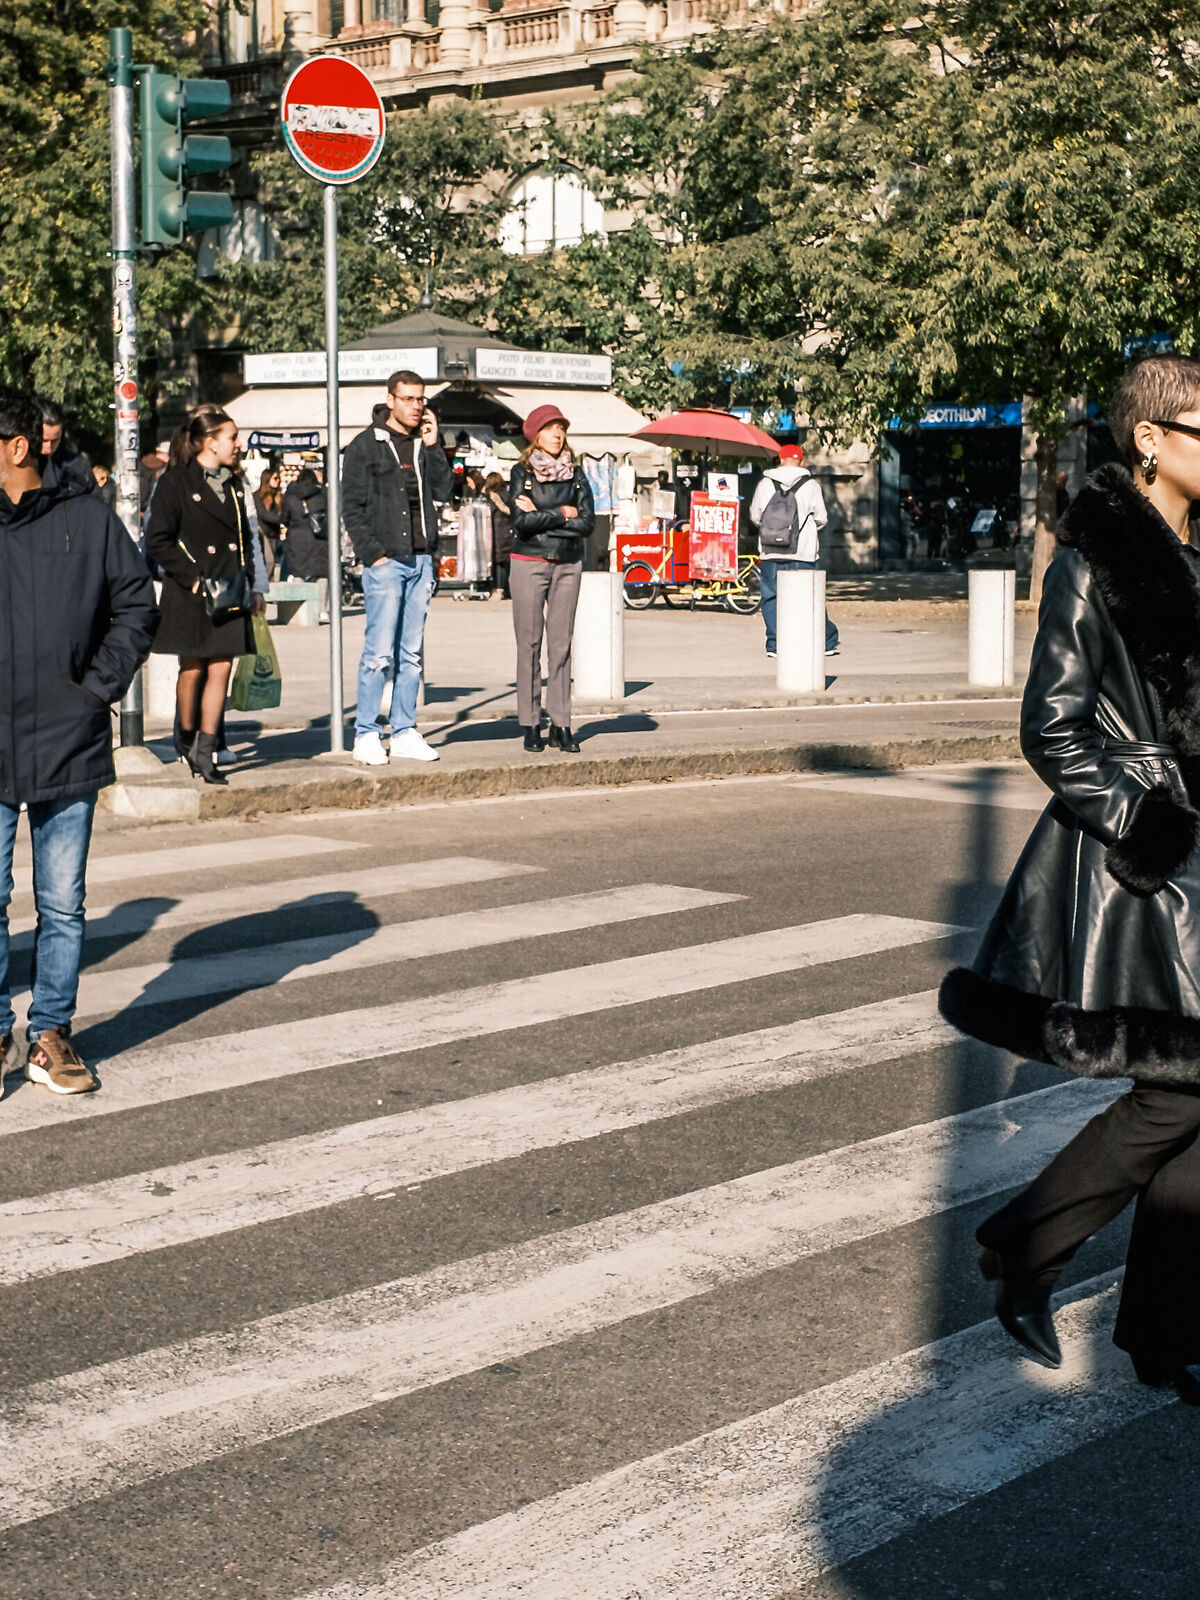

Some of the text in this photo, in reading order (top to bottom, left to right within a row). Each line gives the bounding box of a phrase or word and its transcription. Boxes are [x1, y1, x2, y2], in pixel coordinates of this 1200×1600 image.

[480, 367, 516, 377] GADGETS
[693, 505, 735, 520] TICKETS
[694, 519, 733, 534] HERE
